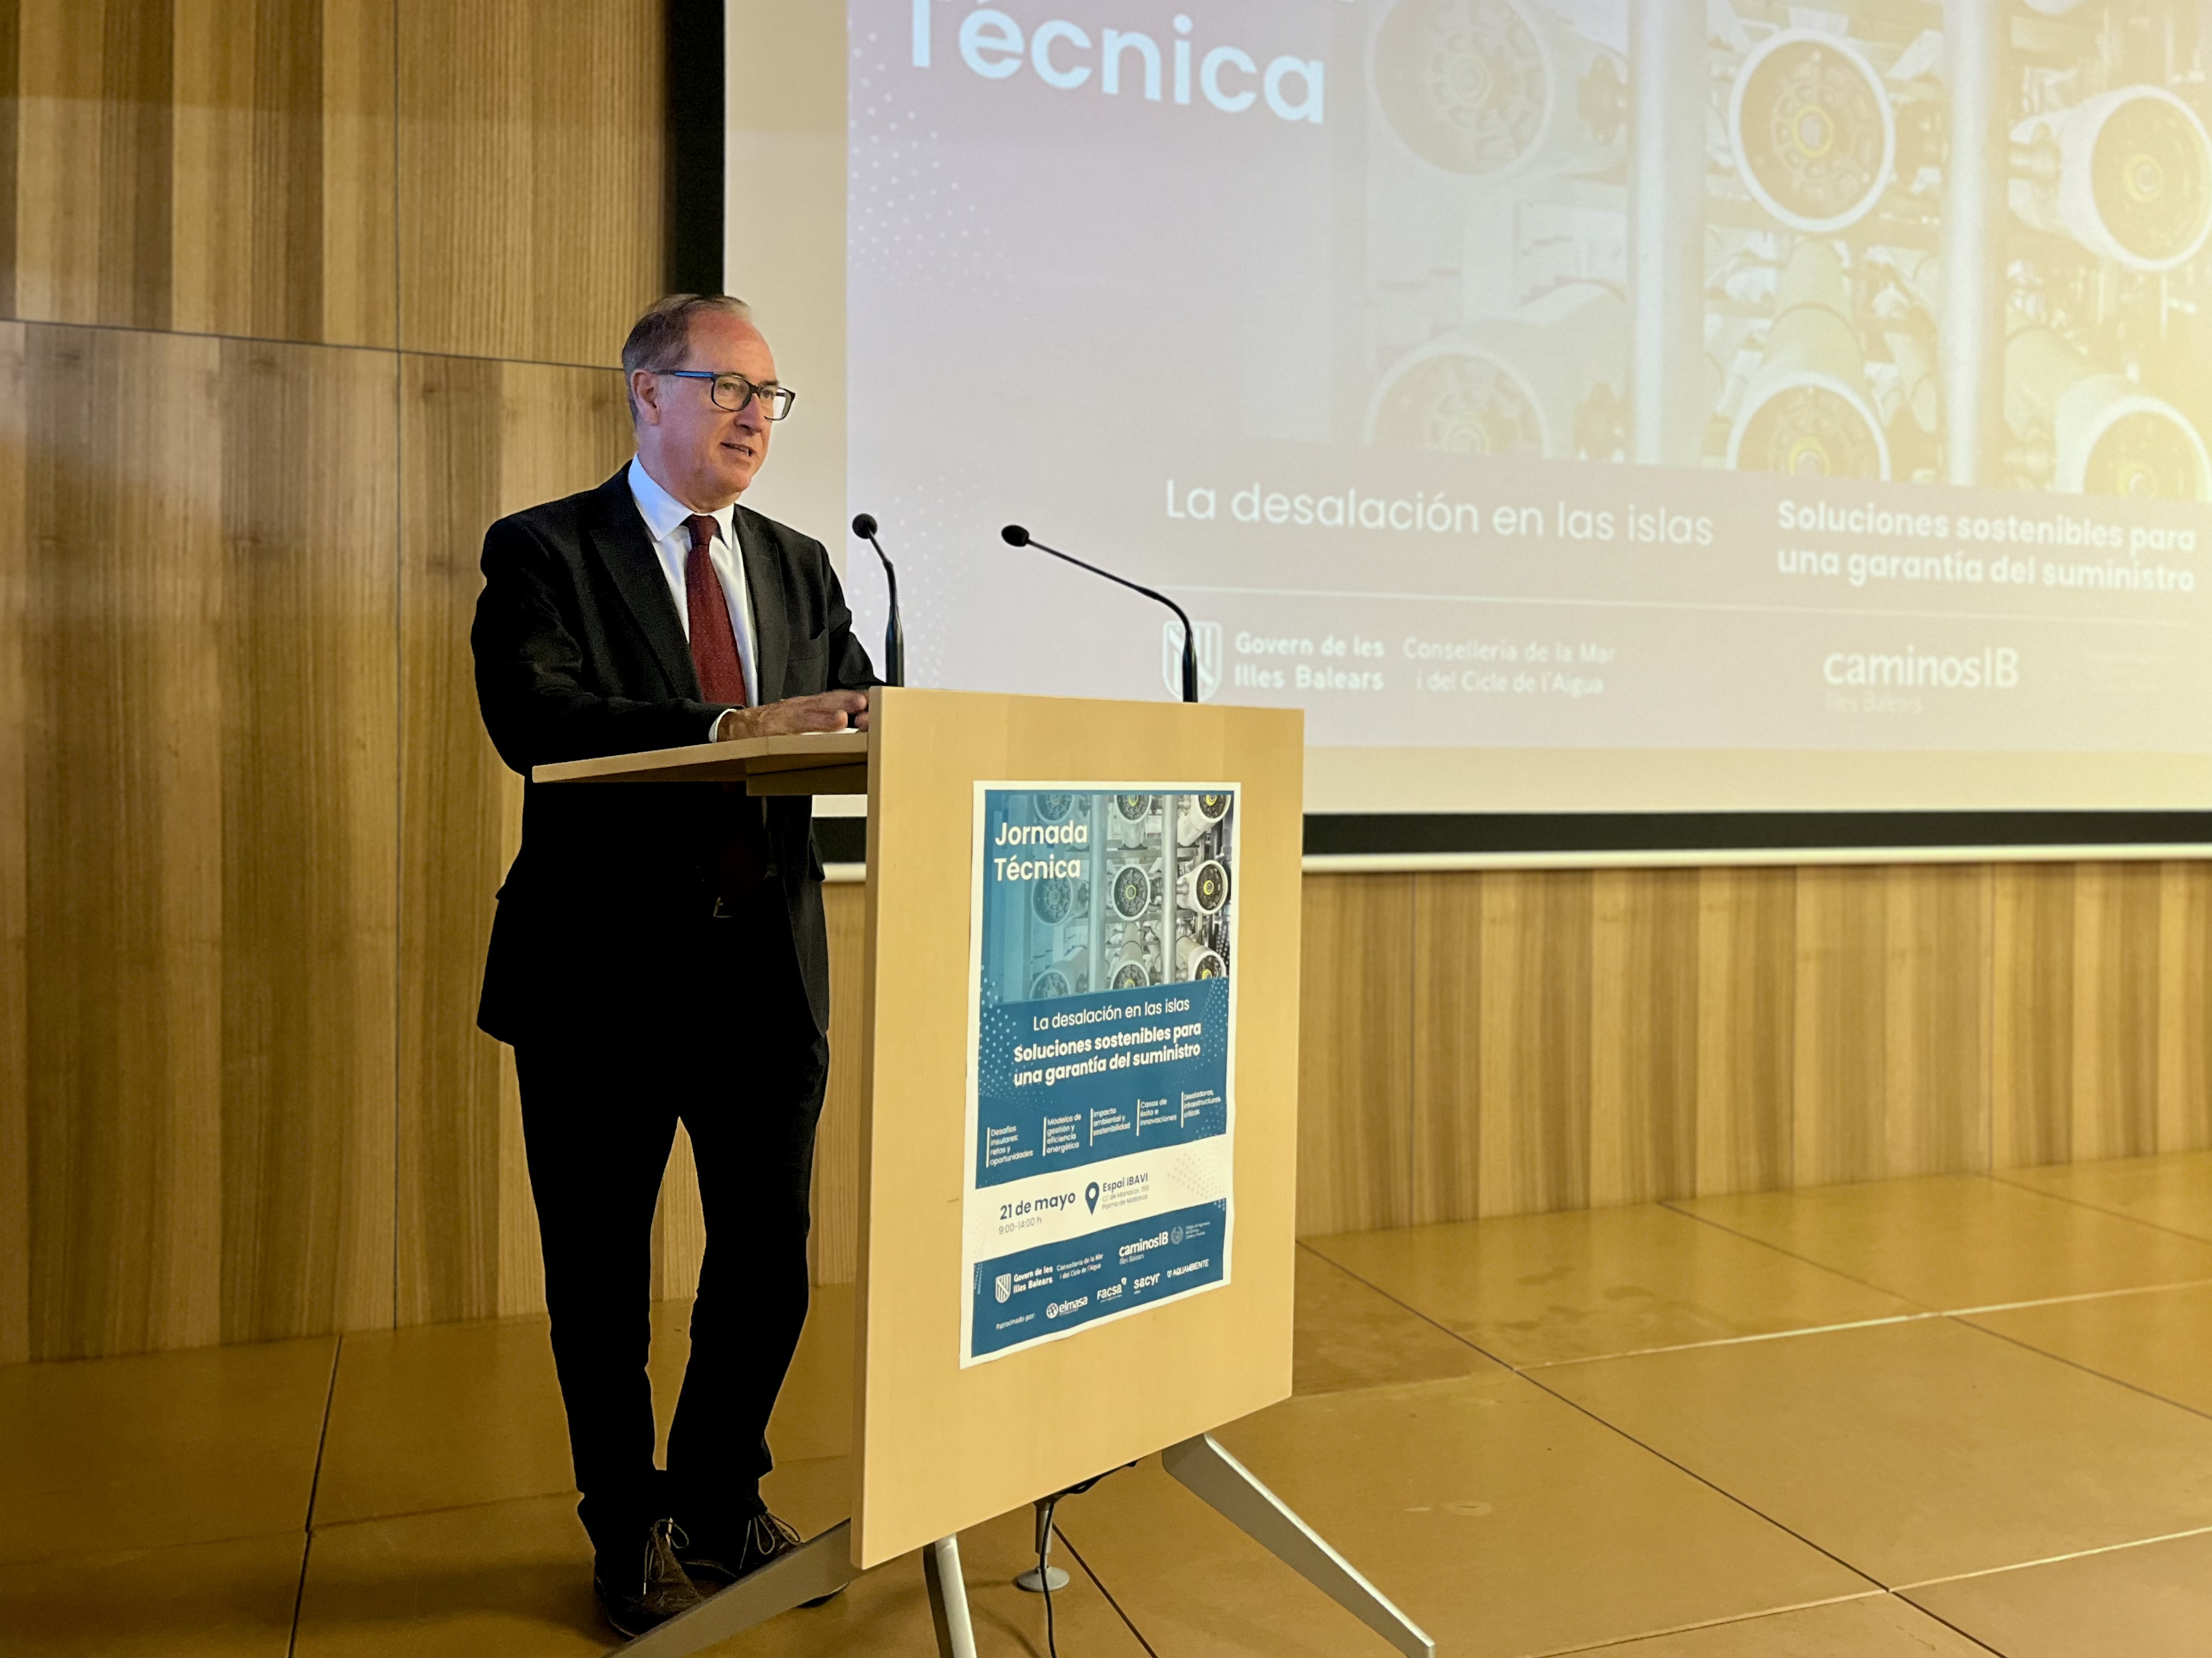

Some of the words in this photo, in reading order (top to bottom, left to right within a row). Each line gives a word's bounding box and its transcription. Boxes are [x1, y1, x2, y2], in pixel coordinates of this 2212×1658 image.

[912, 0, 1324, 124] Técnica
[1165, 479, 1216, 521] La
[1232, 483, 1480, 534] desalación
[1492, 502, 1545, 538] en
[1557, 501, 1615, 540] las
[1627, 504, 1714, 546] islas
[1777, 499, 1949, 539] Soluciones
[1956, 514, 2123, 549] sostenibles
[2130, 525, 2197, 557] para
[1777, 548, 1840, 575] una
[1847, 550, 1983, 587] garantía
[1989, 555, 2037, 585] del
[2041, 559, 2196, 593] suministro
[1234, 631, 1314, 657] Govern
[1320, 635, 1347, 657] de
[1353, 635, 1386, 657] les
[1402, 636, 1519, 663] Conselleria
[1524, 640, 1548, 663] de
[1555, 642, 1573, 663] la
[1580, 642, 1618, 664] Mar
[1234, 663, 1285, 689] Illes
[1295, 664, 1385, 691] Balears
[1823, 645, 2020, 689] caminosIB
[1427, 671, 1457, 692] del
[1461, 670, 1509, 692] Cicle
[1513, 671, 1537, 694] de
[994, 820, 1088, 846] Jornada
[994, 853, 1081, 881] Técnica
[1033, 1016, 1048, 1032] La
[1051, 1005, 1122, 1028] desalación
[1125, 1005, 1142, 1018] en
[1145, 1001, 1162, 1016] las
[1165, 997, 1190, 1013] islas
[1014, 1039, 1092, 1063] Soluciones
[1094, 1027, 1171, 1051] sostenibles
[1173, 1022, 1202, 1043] para
[1014, 1068, 1043, 1086] una
[1045, 1055, 1107, 1086] garantía
[1109, 1051, 1131, 1070] del
[1133, 1043, 1201, 1066] suministro
[1093, 1107, 1117, 1118] Impacto
[1140, 1100, 1159, 1109] Casos
[1047, 1115, 1074, 1126] Modelos
[1074, 1113, 1082, 1122] de
[1093, 1115, 1122, 1127] ambiental
[1093, 1122, 1131, 1136] sostenibilidad
[1140, 1114, 1178, 1127] innovaciones
[991, 1125, 1017, 1137] Desafíos
[1046, 1133, 1076, 1145] eficiencia
[1047, 1124, 1070, 1137] gestión
[1070, 1124, 1076, 1135] y
[990, 1146, 1006, 1156] retos
[1006, 1146, 1012, 1155] y
[1046, 1141, 1080, 1154] energética
[989, 1150, 1034, 1167] oportunidades
[1102, 1176, 1125, 1193] Espai
[1126, 1172, 1148, 1187] IBAVI
[999, 1203, 1012, 1220] 21
[1015, 1200, 1031, 1216] de
[1034, 1192, 1076, 1211] mayo
[998, 1217, 1035, 1235] 9:00-14:00
[1036, 1215, 1042, 1224] h
[1119, 1231, 1169, 1257] caminosIB
[1013, 1270, 1034, 1283] Govern
[1034, 1267, 1043, 1277] de
[1043, 1266, 1053, 1274] les
[1133, 1273, 1161, 1290] sacyr
[1013, 1283, 1027, 1294] Illes
[1028, 1276, 1053, 1290] Balears
[1058, 1295, 1088, 1313] elmasa
[996, 1315, 1025, 1331] Patrocinado
